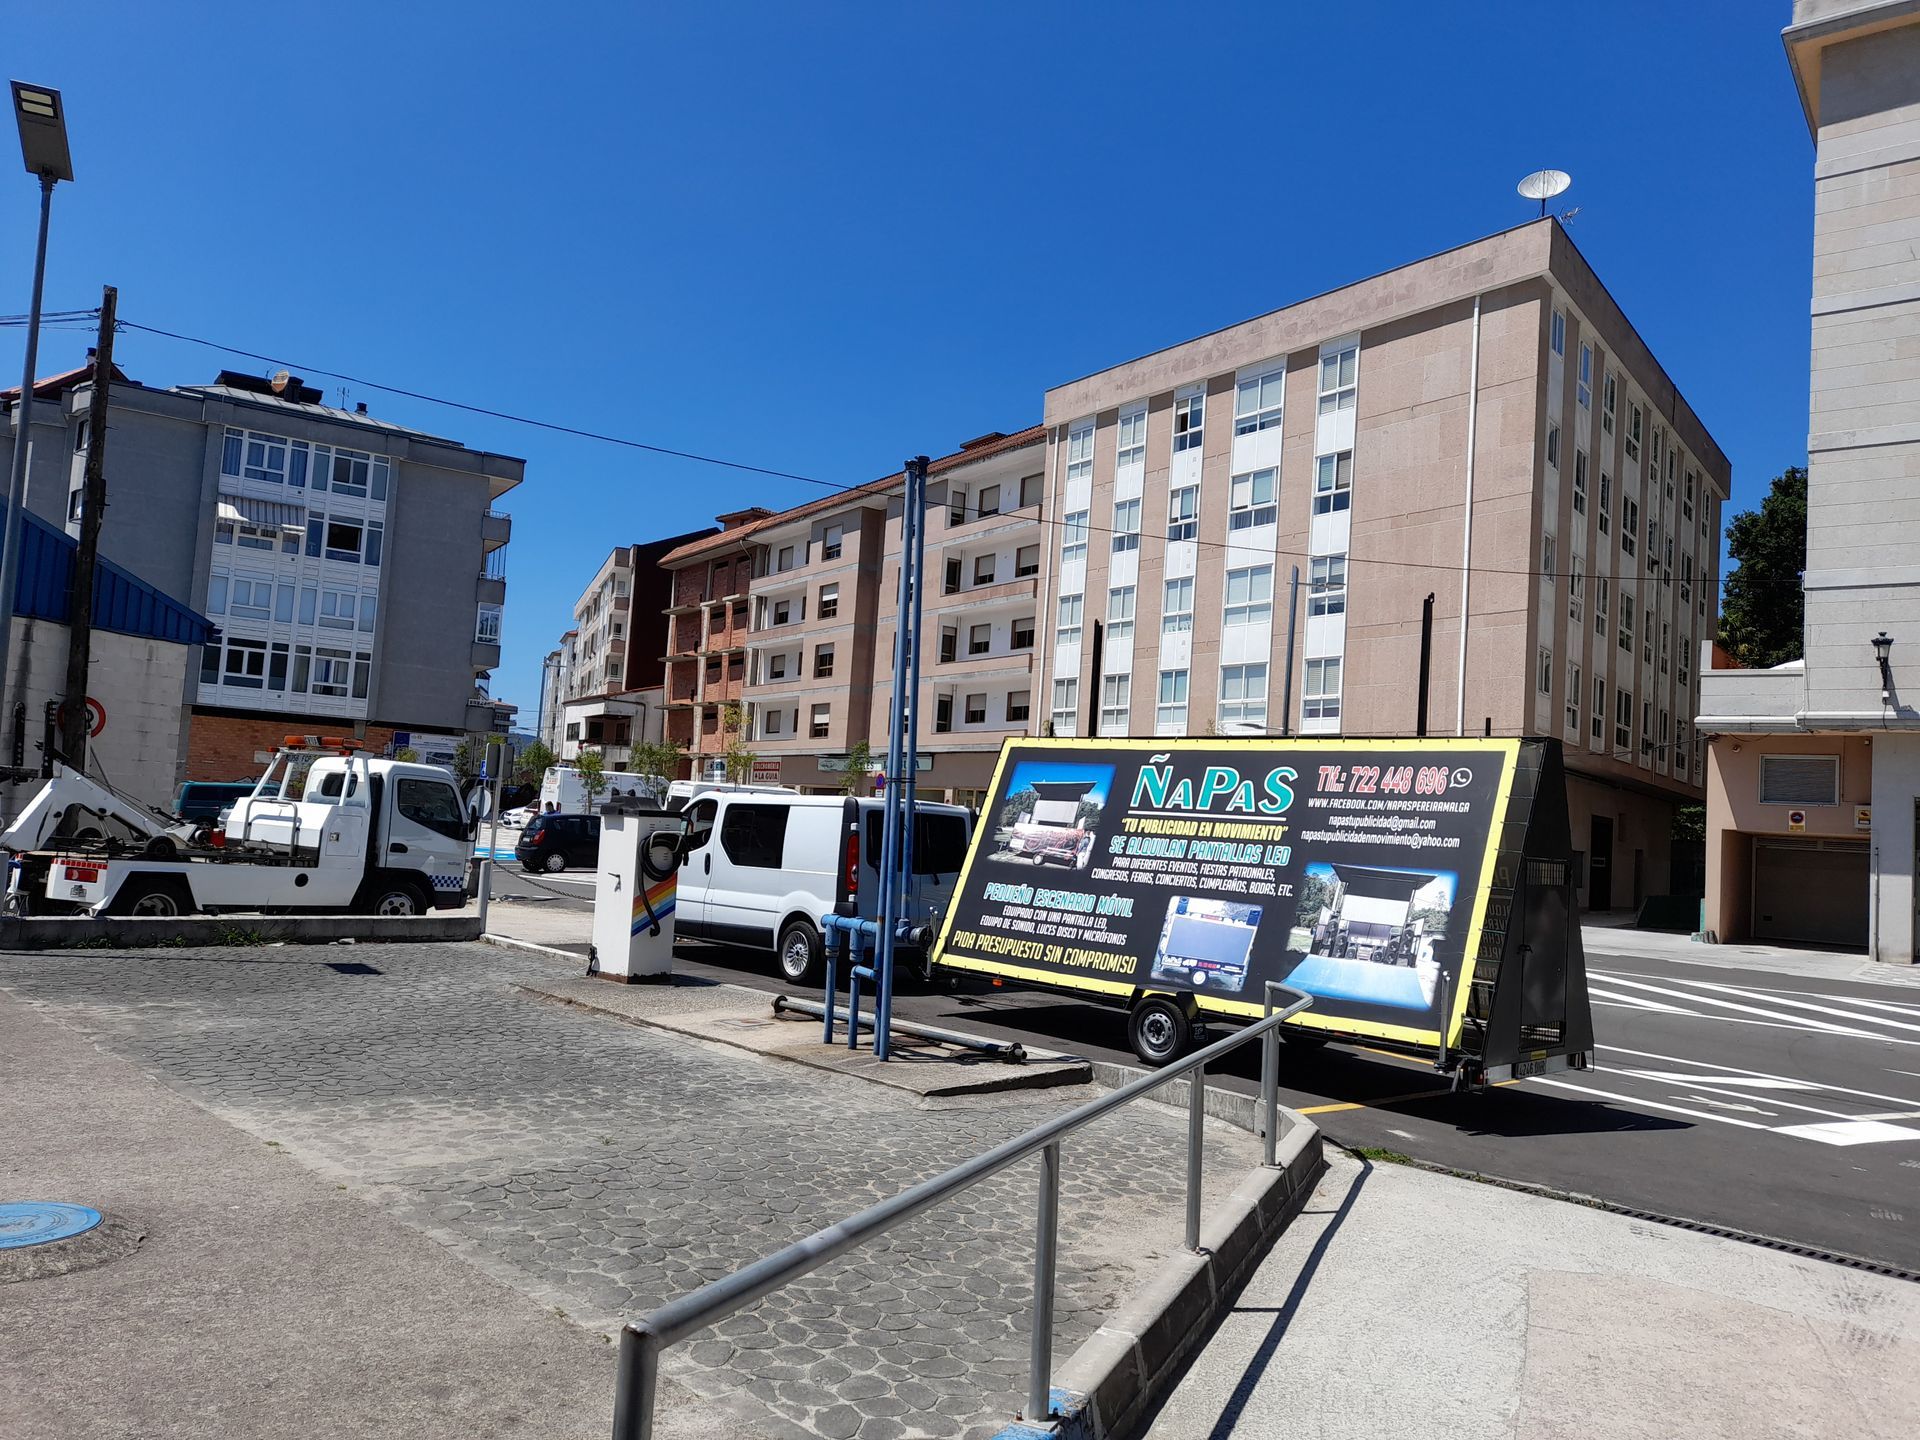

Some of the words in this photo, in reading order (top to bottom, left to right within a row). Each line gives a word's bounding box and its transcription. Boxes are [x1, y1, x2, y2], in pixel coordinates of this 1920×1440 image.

[1349, 766, 1380, 794] 722
[1380, 766, 1414, 795] 448
[1415, 766, 1449, 795] 696
[1138, 820, 1198, 837] PUBLICIDAD
[1198, 822, 1212, 837] EN
[1328, 814, 1437, 831] napastupublicidad@gmail.com
[1109, 836, 1127, 854] SE
[1127, 836, 1187, 859] ALQUILAN
[1187, 840, 1263, 865] PANTALLAS
[1263, 845, 1292, 866] LED
[1301, 829, 1460, 849] napastupublicidadenmovimiento@yahoo.com
[1091, 867, 1130, 883] CONGRESOS,
[1130, 871, 1154, 885] FERIAS,
[1155, 873, 1198, 890] CONCIERTOS,
[1199, 876, 1247, 894] CUMPLEAÑOS,
[1249, 881, 1277, 896] BODAS,
[1277, 883, 1294, 898] ETC.
[1112, 857, 1131, 868] PARA
[1130, 858, 1168, 872] DIFERENTES
[1168, 860, 1199, 875] EVENTOS,
[1200, 863, 1228, 876] FIESTAS
[1228, 865, 1276, 882] PATRONALES,
[983, 881, 1034, 905] PEQUEÑO
[1033, 888, 1096, 912] ESCENARIO
[1095, 893, 1135, 918] MÓVIL
[980, 914, 1003, 928] EQUIPO
[1003, 918, 1011, 929] DE
[1011, 919, 1035, 934] SONIDO,
[1036, 923, 1057, 936] LUCES
[1056, 926, 1077, 938] DISCO
[1077, 929, 1084, 939] Y
[1083, 929, 1128, 946] MICRÓFONOS
[1002, 905, 1034, 919] EQUIPADO
[1033, 909, 1049, 921] CON
[1048, 911, 1065, 923] UNA
[1062, 914, 1094, 927] PANTALLA
[1094, 917, 1108, 931] LED,
[952, 930, 976, 949] PIDA
[975, 933, 1045, 961] PRESUPUESTO
[1044, 944, 1063, 963] SIN
[1063, 947, 1137, 975] COMPROMISO
